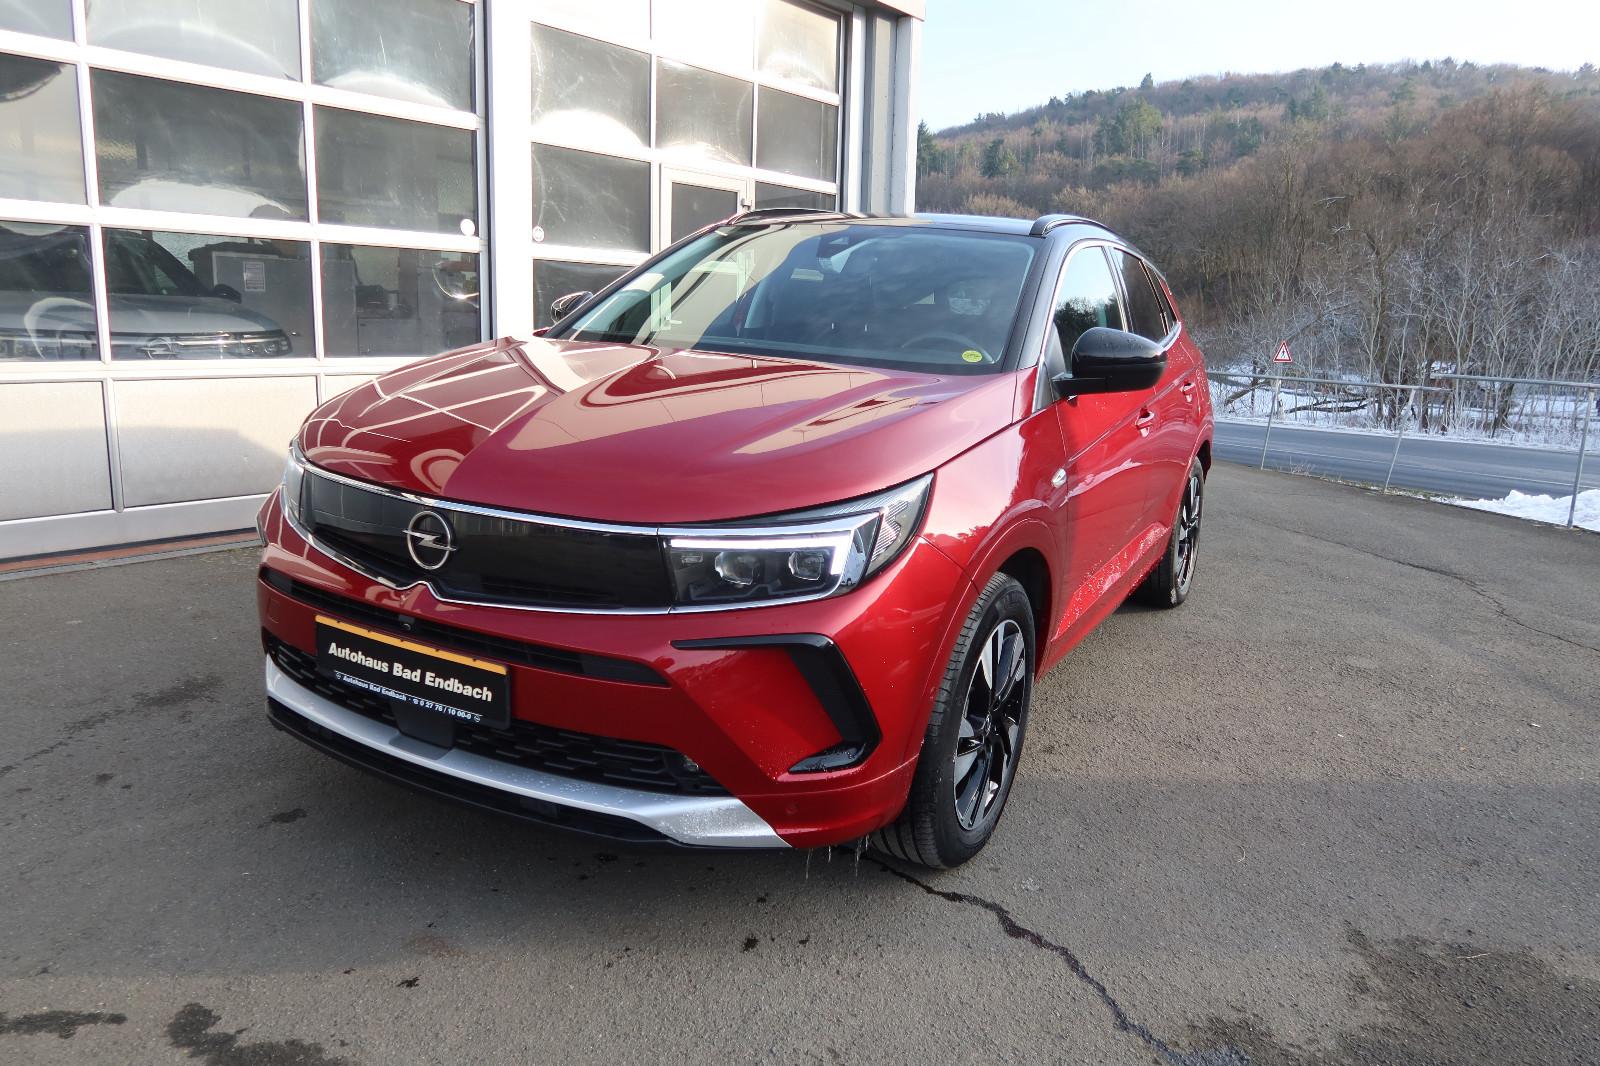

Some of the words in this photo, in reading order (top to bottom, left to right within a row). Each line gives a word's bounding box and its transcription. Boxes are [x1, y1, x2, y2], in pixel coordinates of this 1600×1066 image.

[328, 642, 389, 673] Autohaus
[393, 663, 421, 683] Bad
[425, 672, 493, 702] Endbach
[343, 675, 369, 689] Autohaus
[369, 683, 381, 693] Bad
[381, 688, 407, 701] Endbach
